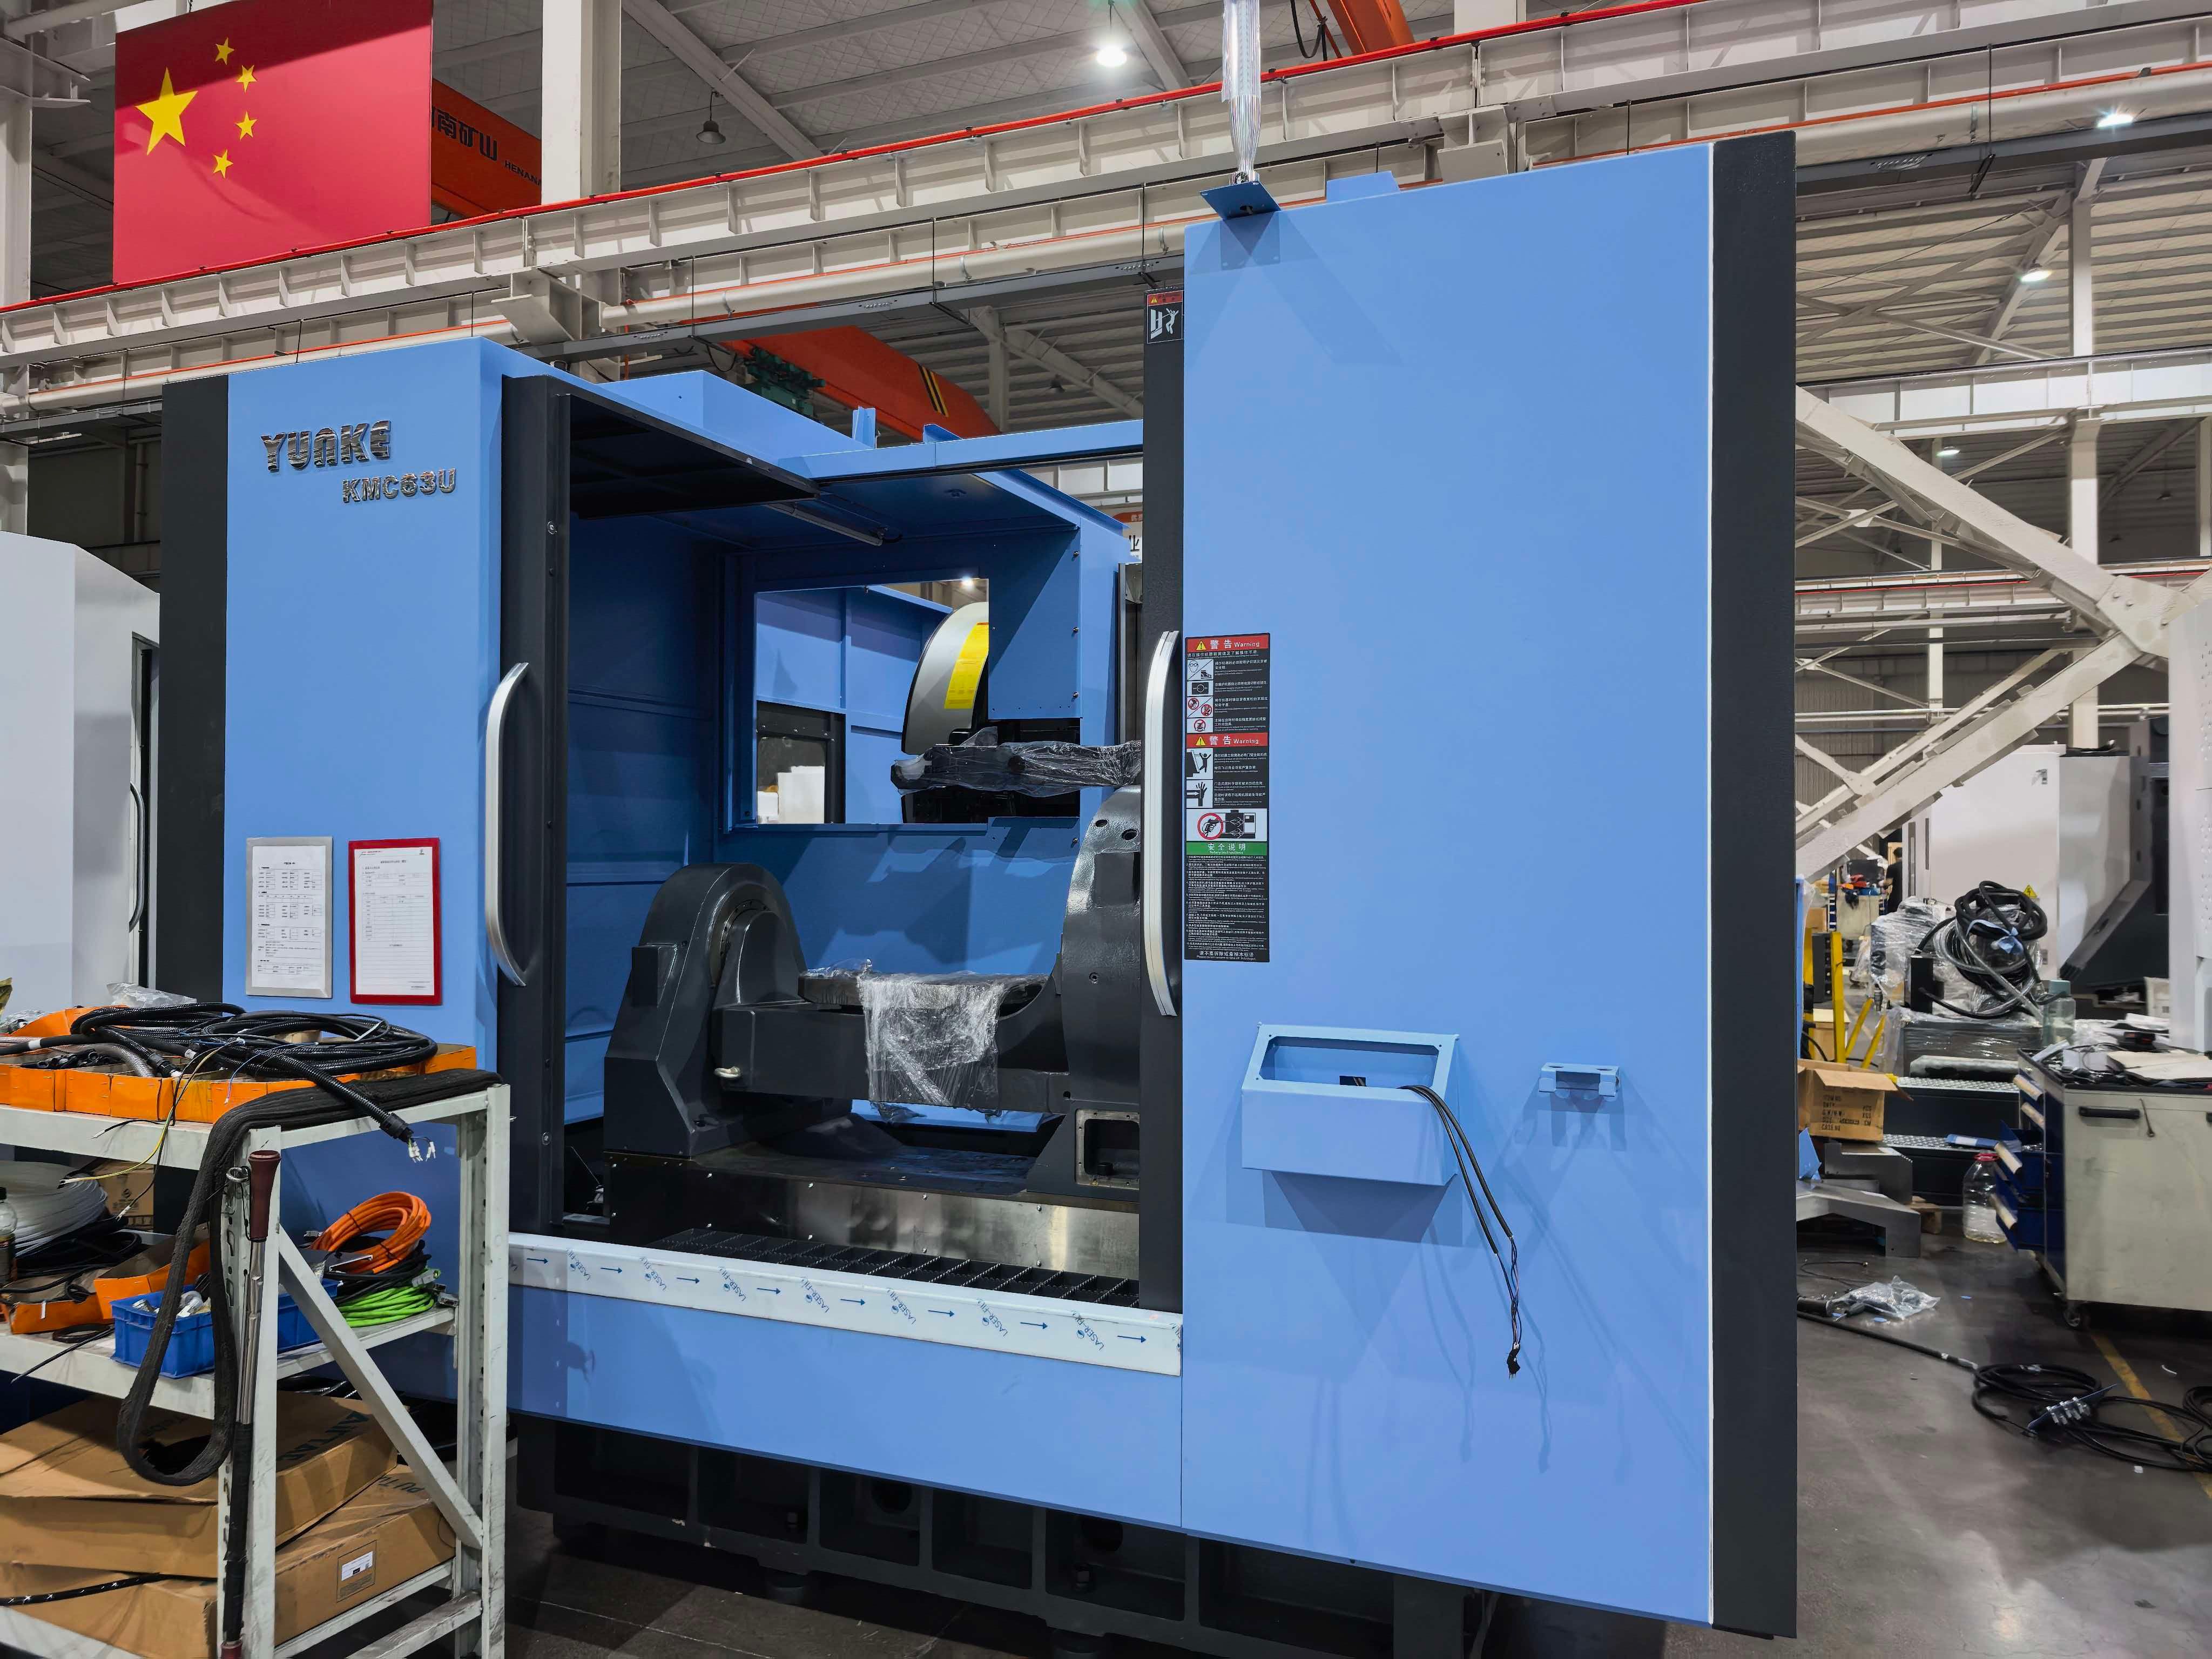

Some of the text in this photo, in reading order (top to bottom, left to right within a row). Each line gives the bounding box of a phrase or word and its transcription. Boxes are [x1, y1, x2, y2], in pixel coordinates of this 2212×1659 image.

[431, 107, 498, 161] 南矿山
[505, 160, 542, 185] HENAN
[1209, 639, 1232, 650] 警告
[1209, 735, 1232, 746] 警告
[1208, 843, 1246, 851] 安全说明
